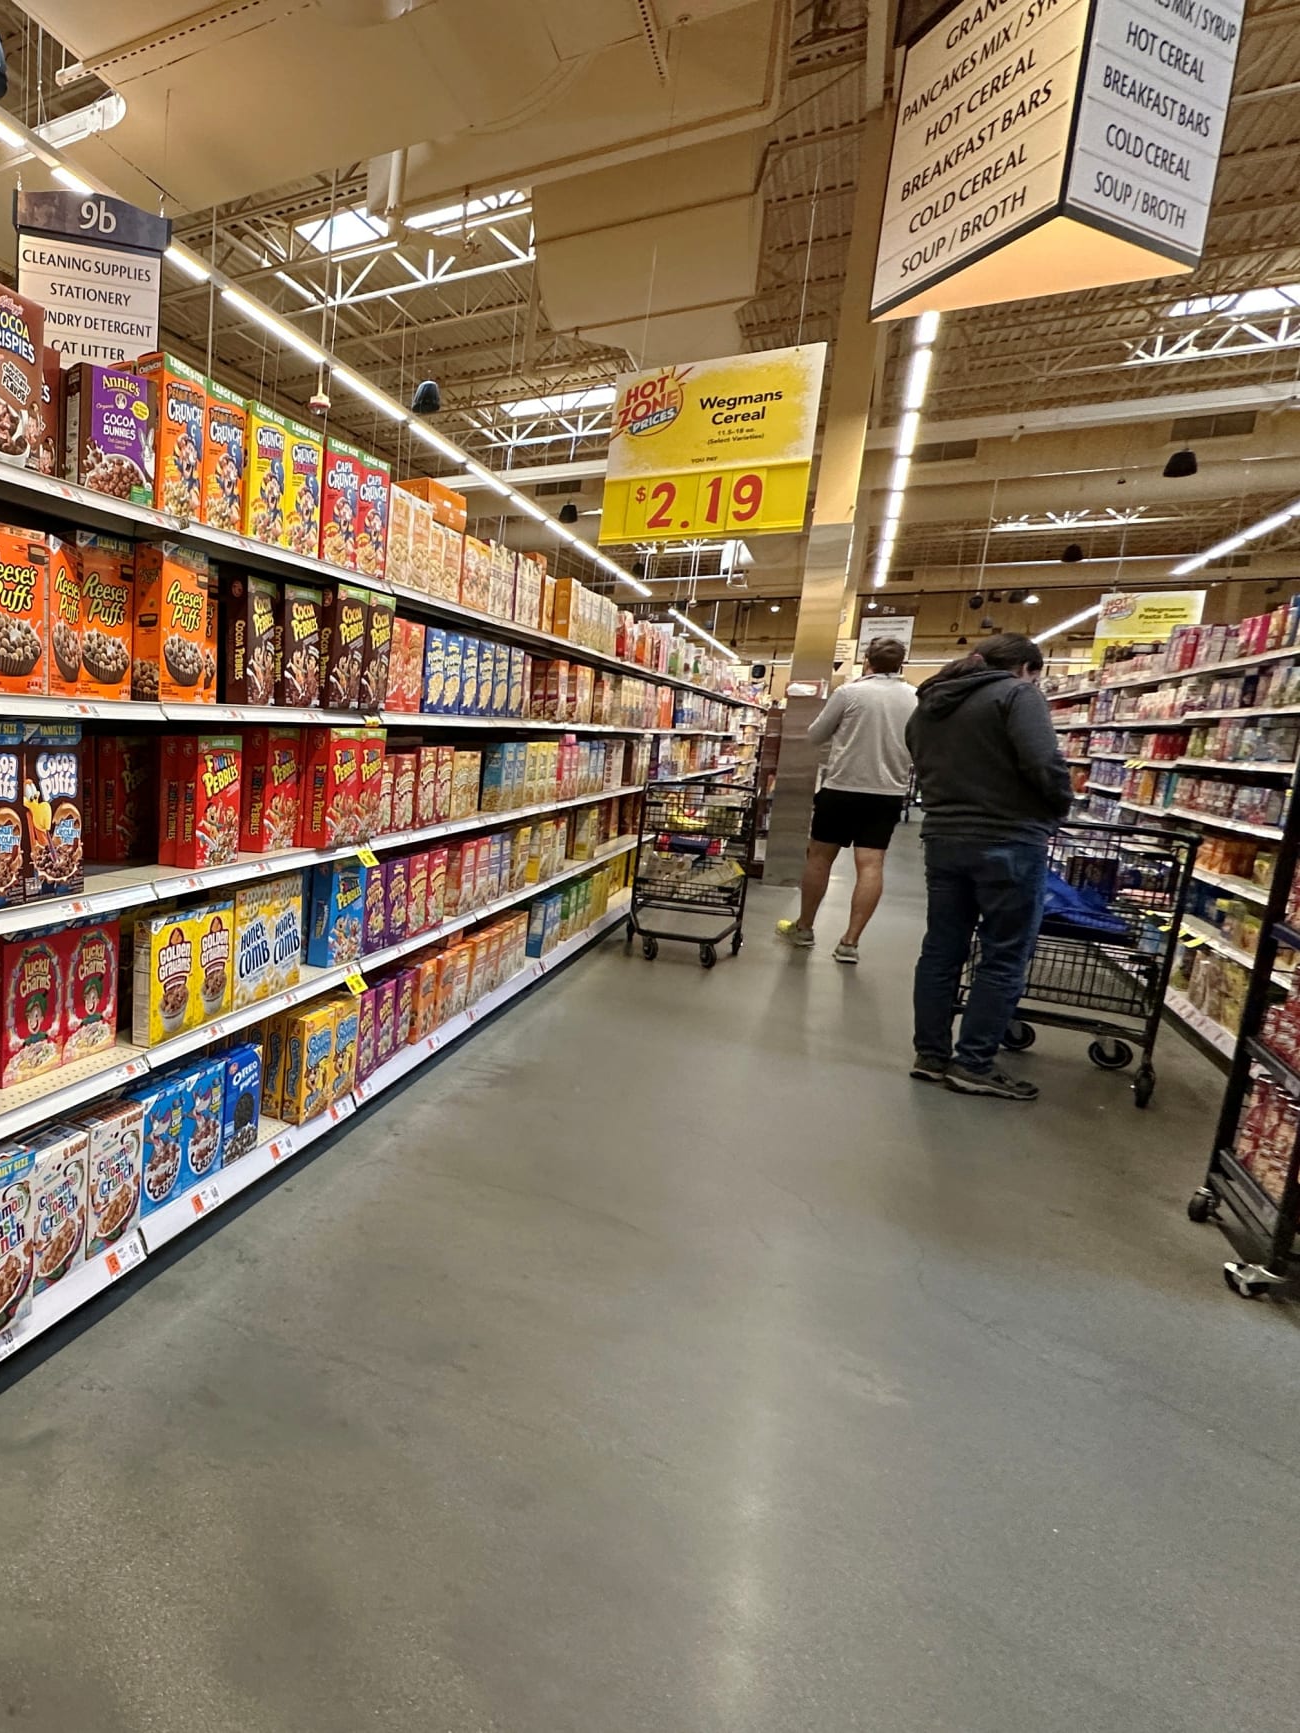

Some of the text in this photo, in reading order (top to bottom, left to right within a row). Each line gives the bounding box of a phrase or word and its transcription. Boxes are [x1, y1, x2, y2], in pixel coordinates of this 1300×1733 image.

[946, 0, 1004, 49] GRAN
[1201, 8, 1237, 44] SYRUP
[1126, 21, 1205, 84] HOT CEREAL
[902, 52, 977, 125] PANCAKES
[979, 22, 1013, 64] MIX
[925, 48, 1037, 146] HOT CEREAL
[1103, 64, 1210, 138] BREAKFAST BARS
[901, 79, 1053, 202] BREAKFAST BARS
[1106, 123, 1191, 181] COLD CEREAL
[909, 144, 1028, 234] COLD CEREAL
[1094, 171, 1132, 202] SOUP
[1142, 191, 1187, 229] BROTH
[80, 200, 117, 234] 9b
[900, 236, 946, 278] SOUP
[960, 186, 1027, 243] BROTH
[22, 249, 151, 282] CLEANING SUPPLIES
[50, 283, 131, 306] STATIONERY
[84, 316, 152, 338] DETERGENT
[51, 340, 125, 362] CAT LITTER
[103, 374, 141, 399] Annie's
[625, 375, 670, 406] HOT
[699, 390, 784, 410] Wegmans
[103, 412, 136, 430] COCOA
[168, 402, 204, 425] CRUNCH
[619, 389, 679, 430] ZONE
[631, 407, 677, 434] PRICES
[711, 406, 767, 426] Cereal
[103, 425, 136, 440] BUNNIES
[210, 421, 243, 446] CRUNCH
[707, 433, 765, 446] (Select Varieties)
[328, 471, 359, 490] CRUNCH
[635, 474, 763, 530] $2.19
[292, 602, 316, 624] COCOA
[291, 615, 319, 641] PEBBLES
[205, 752, 236, 772] FRUITY
[201, 766, 240, 797] PEBBLES
[232, 1060, 260, 1086] OREO
